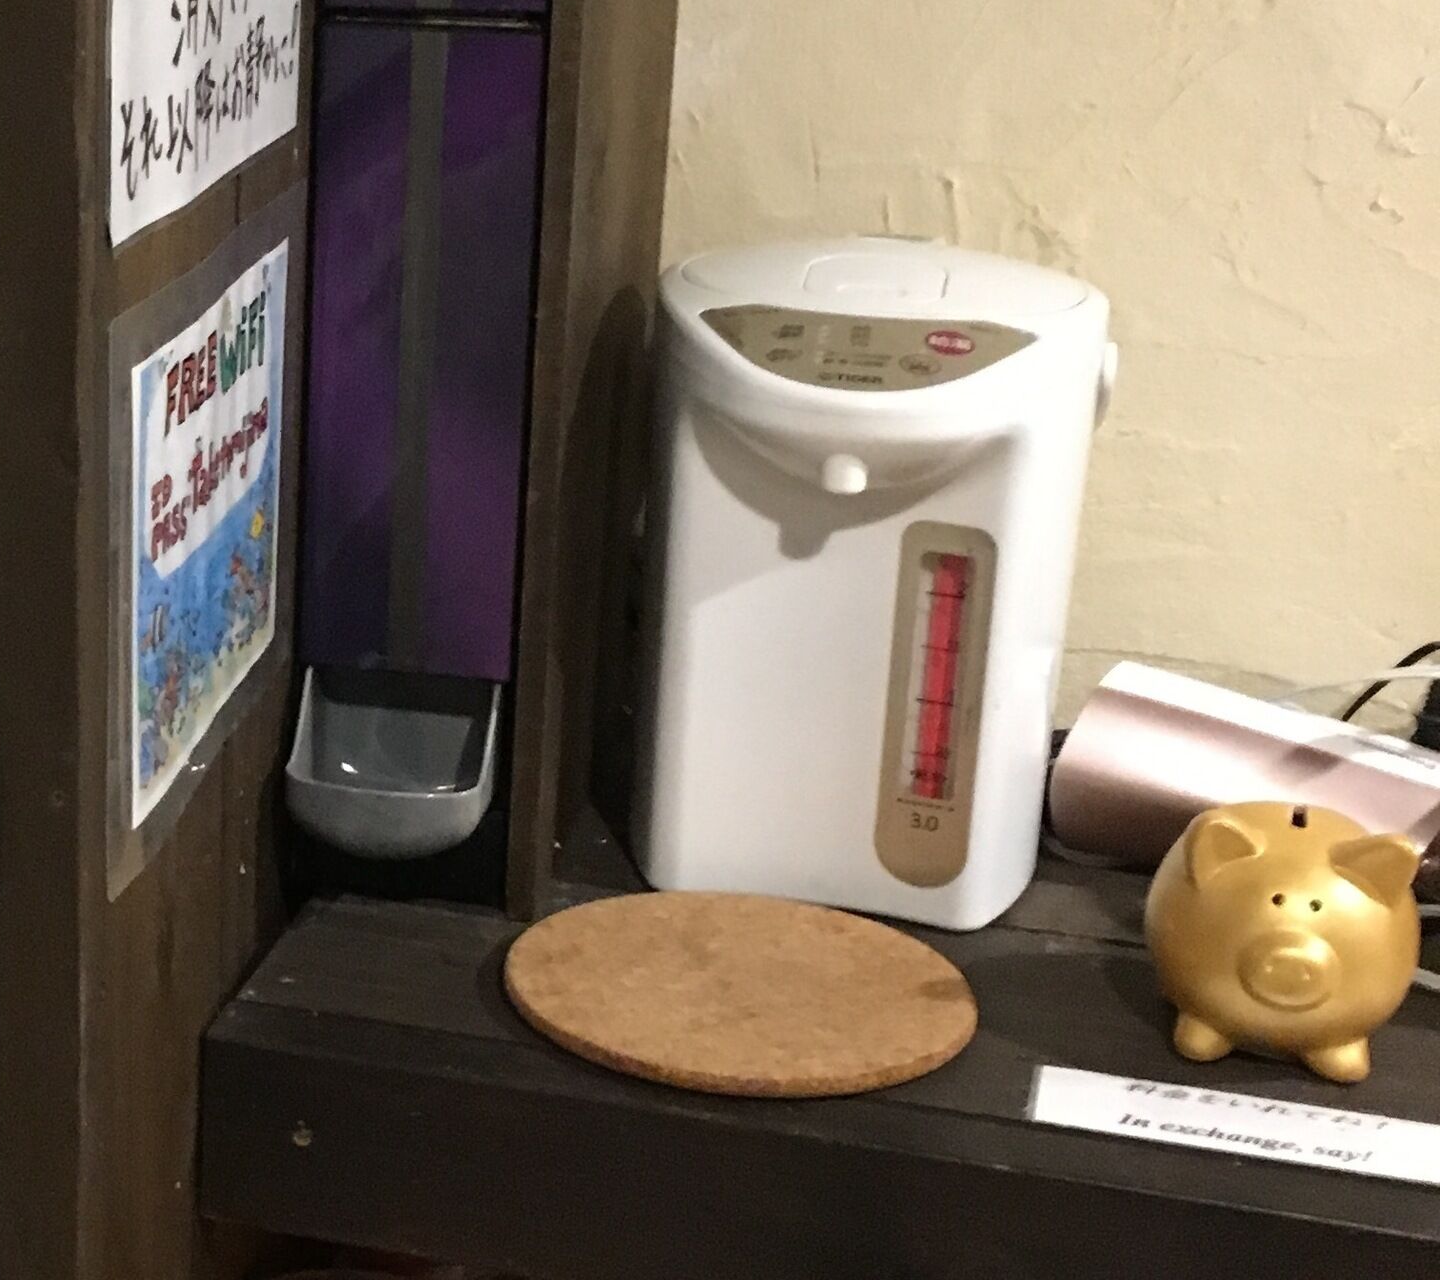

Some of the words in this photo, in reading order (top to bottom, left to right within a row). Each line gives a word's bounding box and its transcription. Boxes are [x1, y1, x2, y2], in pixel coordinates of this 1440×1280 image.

[164, 330, 217, 437] FREE
[838, 373, 883, 384] TIGER
[910, 811, 939, 832] 3.0
[1118, 1112, 1150, 1128] In
[1160, 1118, 1303, 1154] exchange,
[1313, 1144, 1373, 1163] say!
